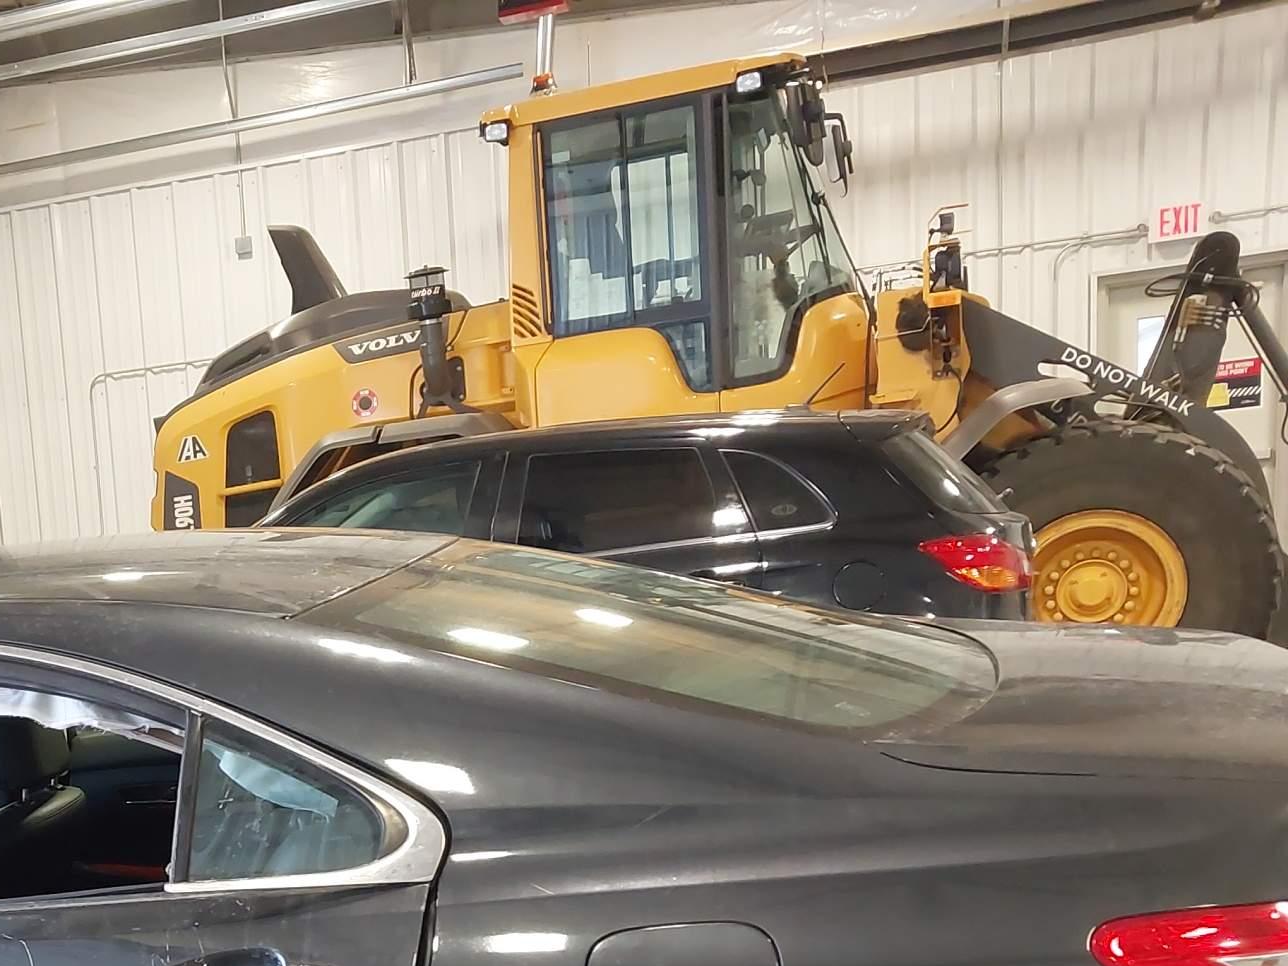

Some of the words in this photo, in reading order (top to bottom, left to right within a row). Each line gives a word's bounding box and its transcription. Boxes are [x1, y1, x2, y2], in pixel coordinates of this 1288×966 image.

[1159, 204, 1201, 237] EXIT
[348, 330, 421, 355] VOLV
[1061, 347, 1092, 369] DO
[1093, 361, 1138, 389] NOT
[1140, 381, 1195, 416] WALK
[173, 495, 195, 530] 90H
